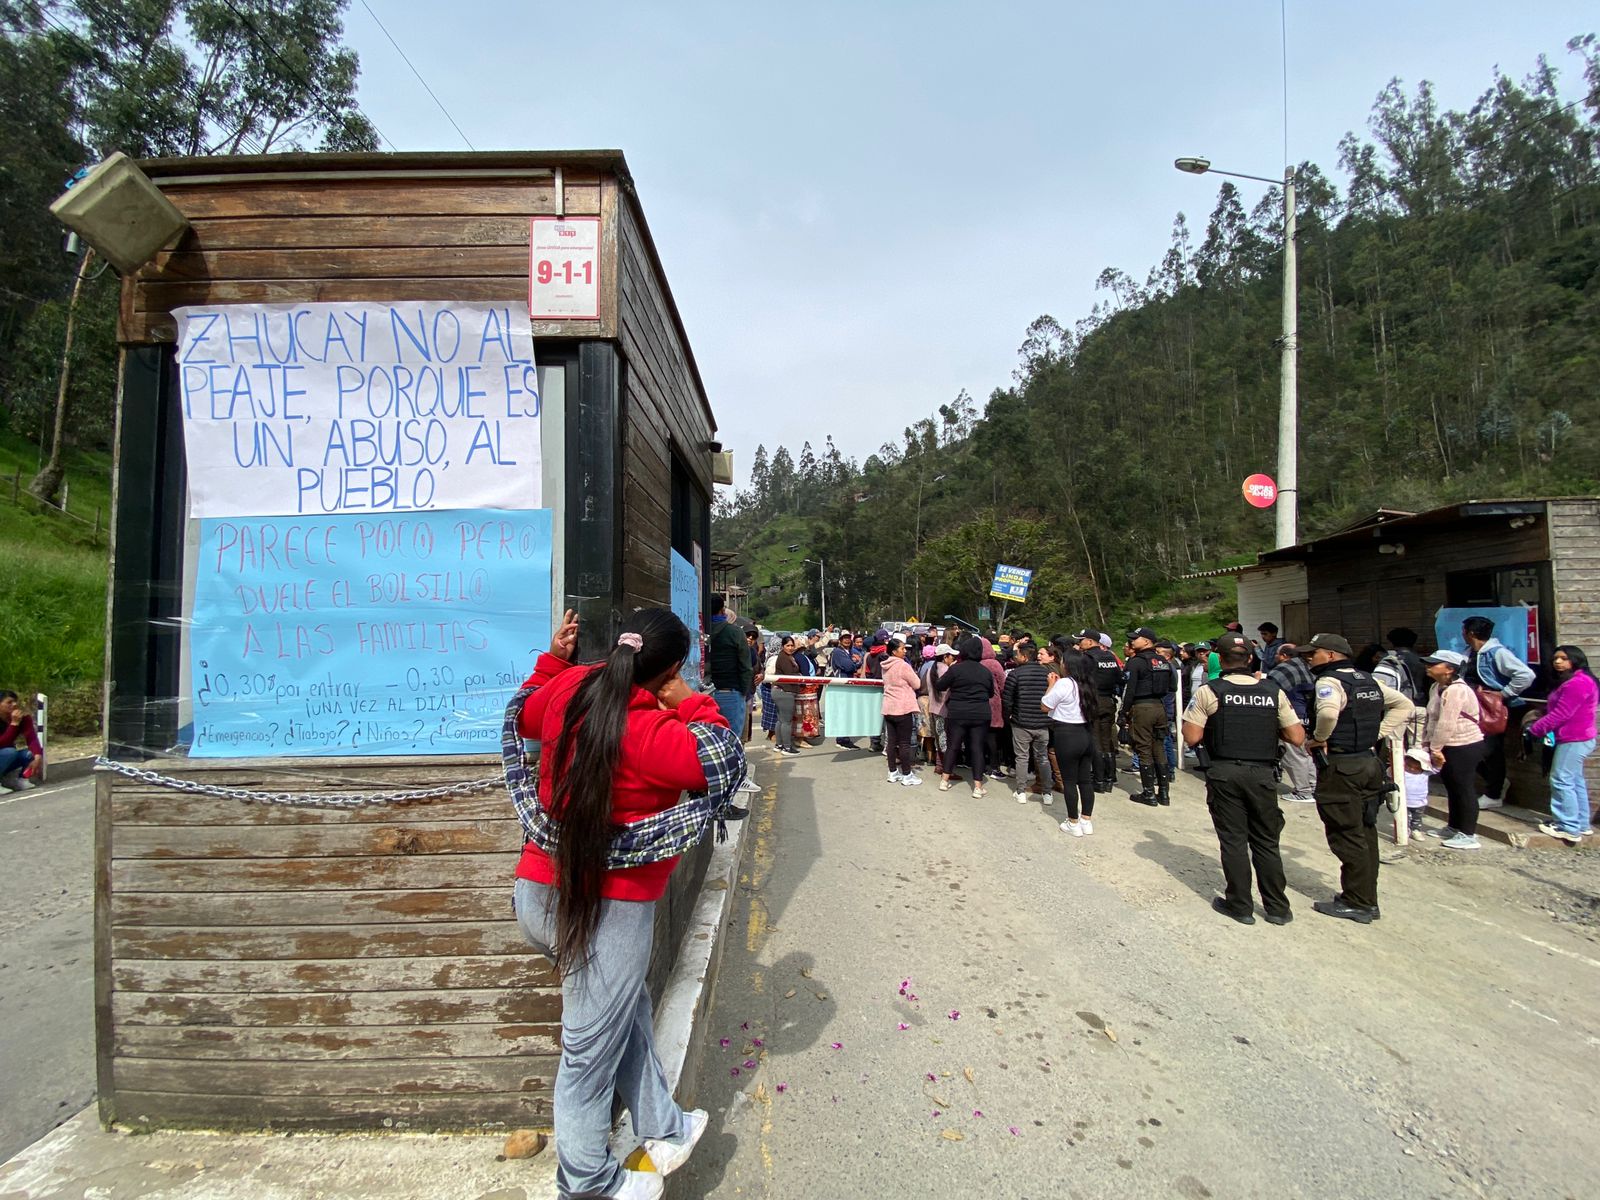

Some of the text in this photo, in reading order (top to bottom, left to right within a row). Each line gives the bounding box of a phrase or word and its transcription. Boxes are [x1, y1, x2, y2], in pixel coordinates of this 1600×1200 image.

[537, 260, 592, 284] 9-1-1
[183, 308, 531, 364] ZHUCAY NO AL
[184, 364, 540, 424] PEAJE, PORQUE ES
[233, 419, 517, 471] UN ABUSO, AL
[297, 468, 436, 513] PUEBLO.
[215, 520, 536, 573] PARECE POCO PERO
[235, 568, 491, 615] DUELE EL BOLSILLO
[1001, 573, 1024, 582] LINDA
[1008, 567, 1031, 577] VENDE
[243, 619, 489, 658] A LAS FAMILIAS
[309, 672, 361, 698] entrar
[1225, 694, 1275, 707] POLICIA
[350, 699, 377, 714] VEZ
[387, 697, 406, 711] AL
